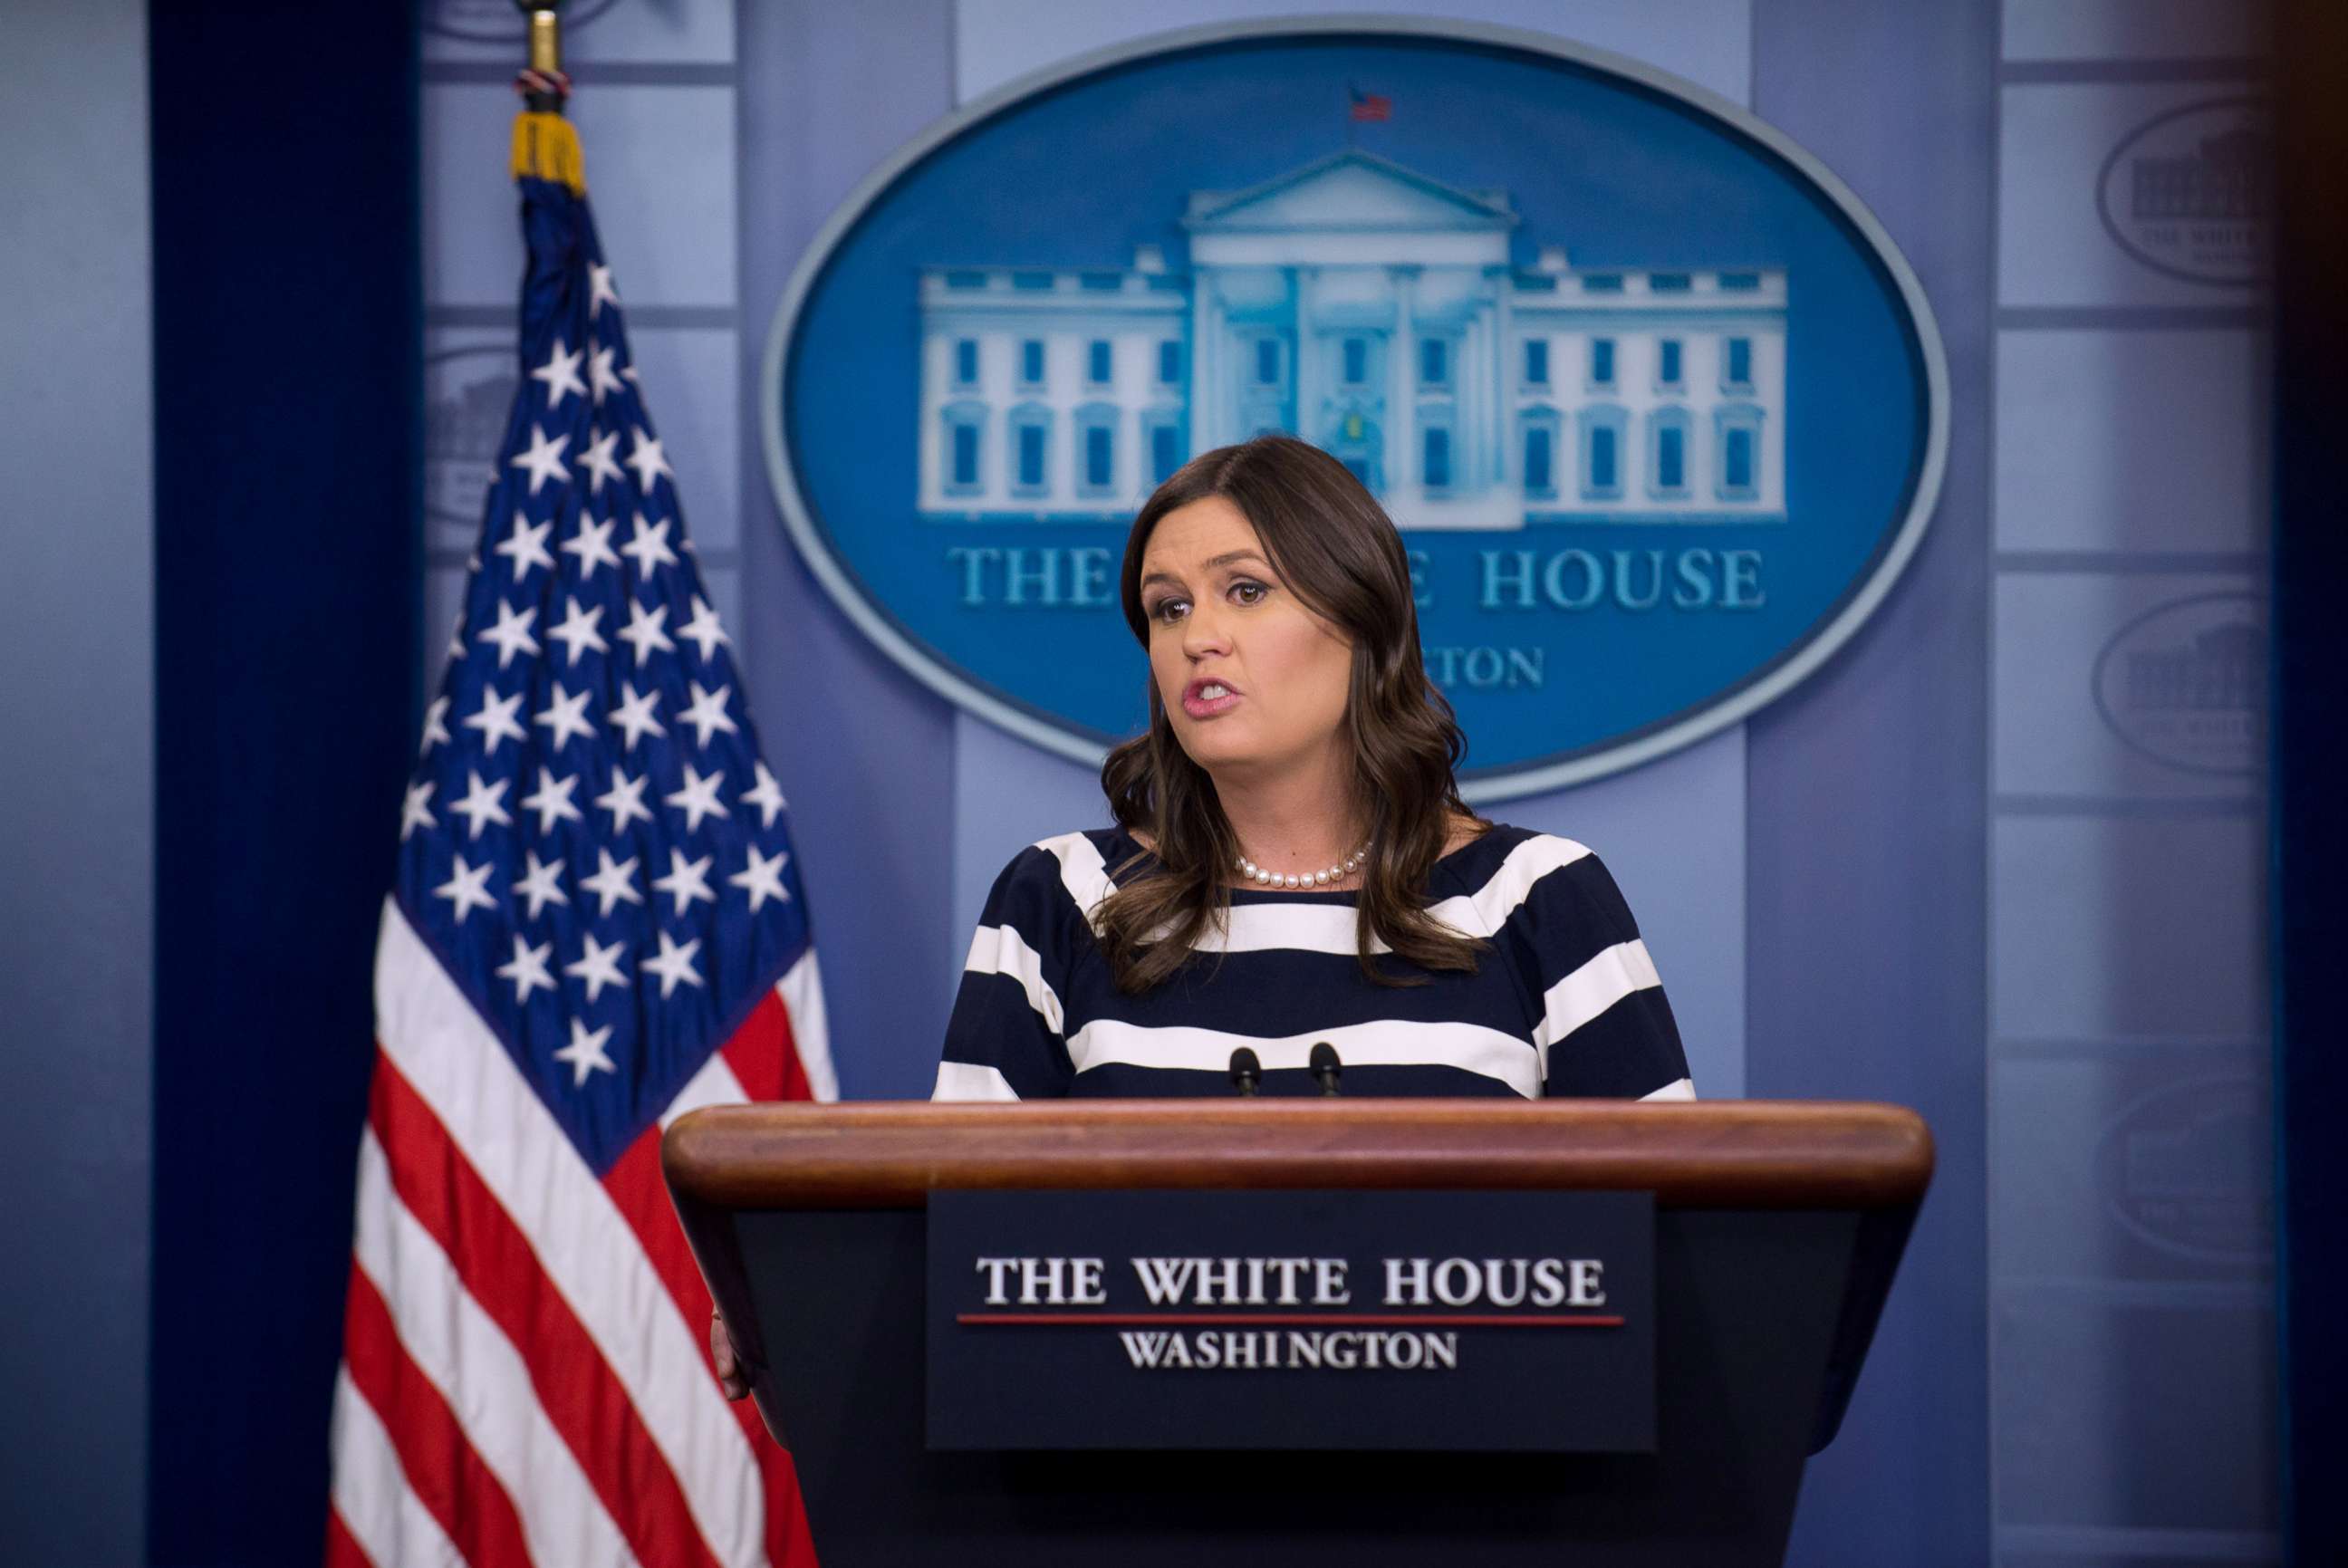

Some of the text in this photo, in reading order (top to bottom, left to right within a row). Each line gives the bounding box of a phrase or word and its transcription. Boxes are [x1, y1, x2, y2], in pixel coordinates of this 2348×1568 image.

[945, 547, 1114, 605] THE
[1479, 548, 1766, 609] HOUSE
[976, 1256, 1606, 1306] THE WHITE HOUSE
[1120, 1331, 1458, 1370] WASHINGTON
